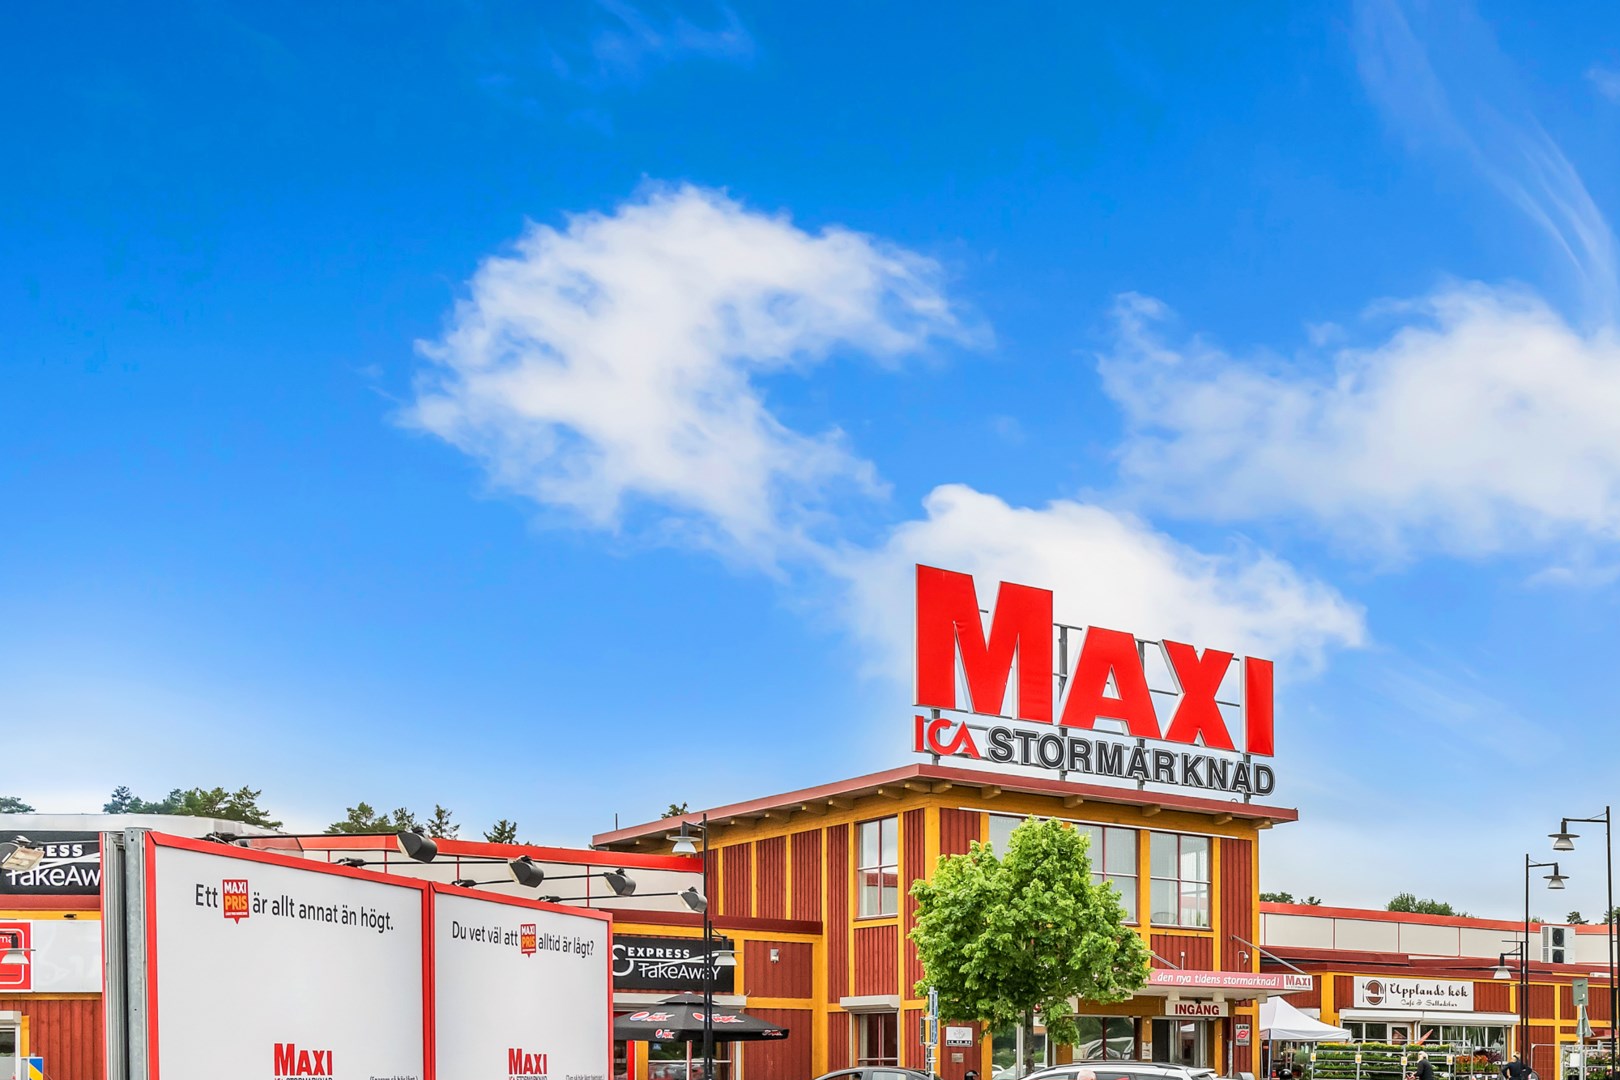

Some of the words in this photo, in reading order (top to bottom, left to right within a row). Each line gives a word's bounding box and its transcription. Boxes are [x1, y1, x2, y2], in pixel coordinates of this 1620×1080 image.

[912, 563, 1275, 758] MAXI
[912, 714, 982, 760] ICA
[987, 725, 1276, 797] STORMARKNAD
[195, 883, 218, 908] Ett
[224, 881, 247, 894] MAXI
[225, 895, 248, 910] PRIS
[252, 892, 268, 914] är
[272, 895, 295, 918] allt
[299, 903, 338, 924] annat
[341, 905, 357, 926] än
[361, 906, 394, 933] högt.
[452, 921, 467, 940] Du
[469, 926, 486, 943] vet
[488, 926, 502, 944] väl
[504, 930, 518, 947] att
[521, 936, 536, 948] PRIS
[538, 933, 560, 951] alltid
[563, 936, 572, 953] är
[573, 936, 595, 958] lågt?
[627, 947, 690, 959] EXPRESS
[1176, 974, 1192, 984] nya
[1194, 973, 1221, 984] tidens
[1223, 975, 1280, 987] stormarknad!
[1285, 974, 1311, 986] MAXI
[1389, 982, 1445, 998] Upplands
[274, 1043, 333, 1076] MAXI
[508, 1048, 547, 1075] MAXI
